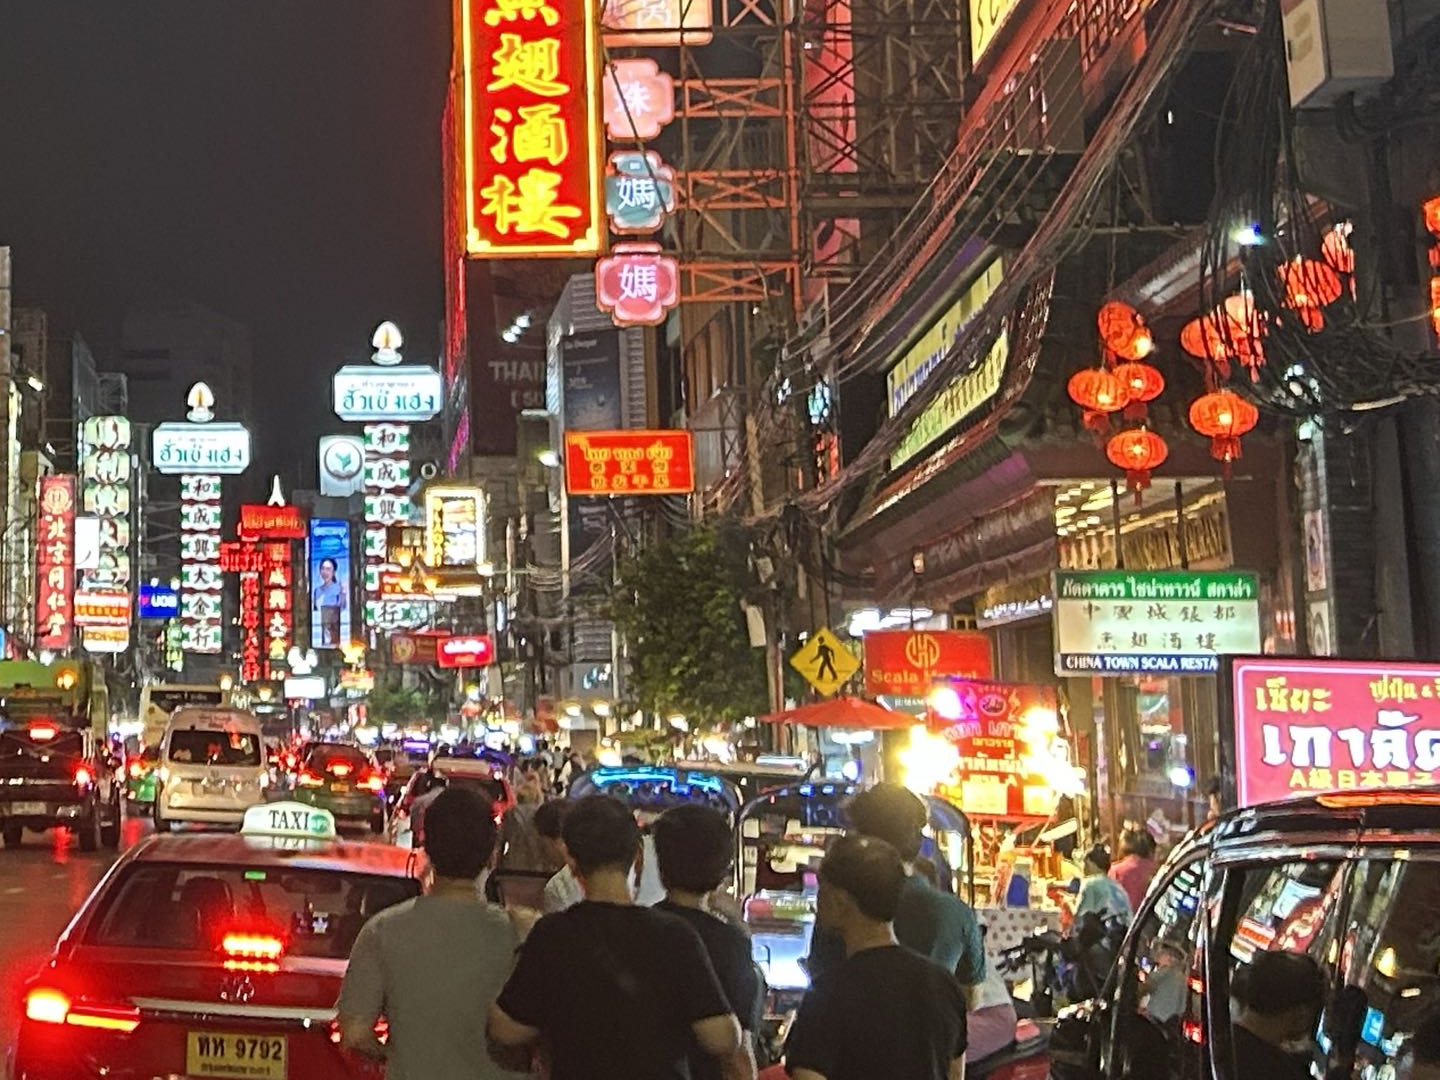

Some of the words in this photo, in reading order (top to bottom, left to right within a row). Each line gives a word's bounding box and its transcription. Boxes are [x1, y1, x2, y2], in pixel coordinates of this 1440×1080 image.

[376, 427, 399, 624] 和成興行
[1066, 656, 1102, 670] CHINA
[1103, 656, 1140, 670] TOWN
[1141, 656, 1179, 670] SCALA
[871, 670, 919, 684] Scala
[268, 809, 310, 831] TAXI
